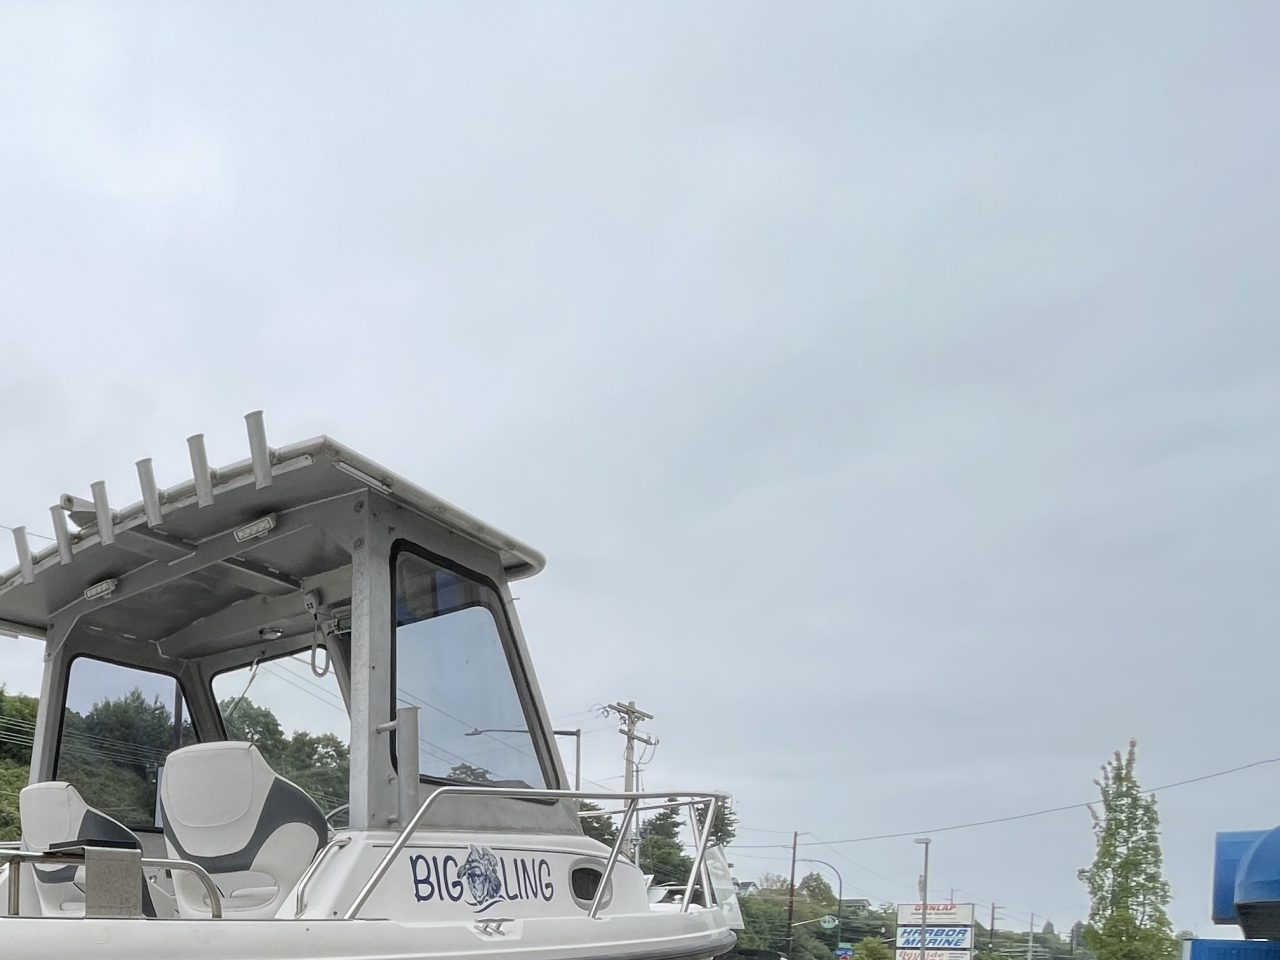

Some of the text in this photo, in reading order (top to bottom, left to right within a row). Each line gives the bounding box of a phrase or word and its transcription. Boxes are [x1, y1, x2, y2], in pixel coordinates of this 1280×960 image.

[409, 854, 554, 902] BIG LING
[901, 928, 969, 937] HARBOR
[899, 951, 945, 960] Bayide
